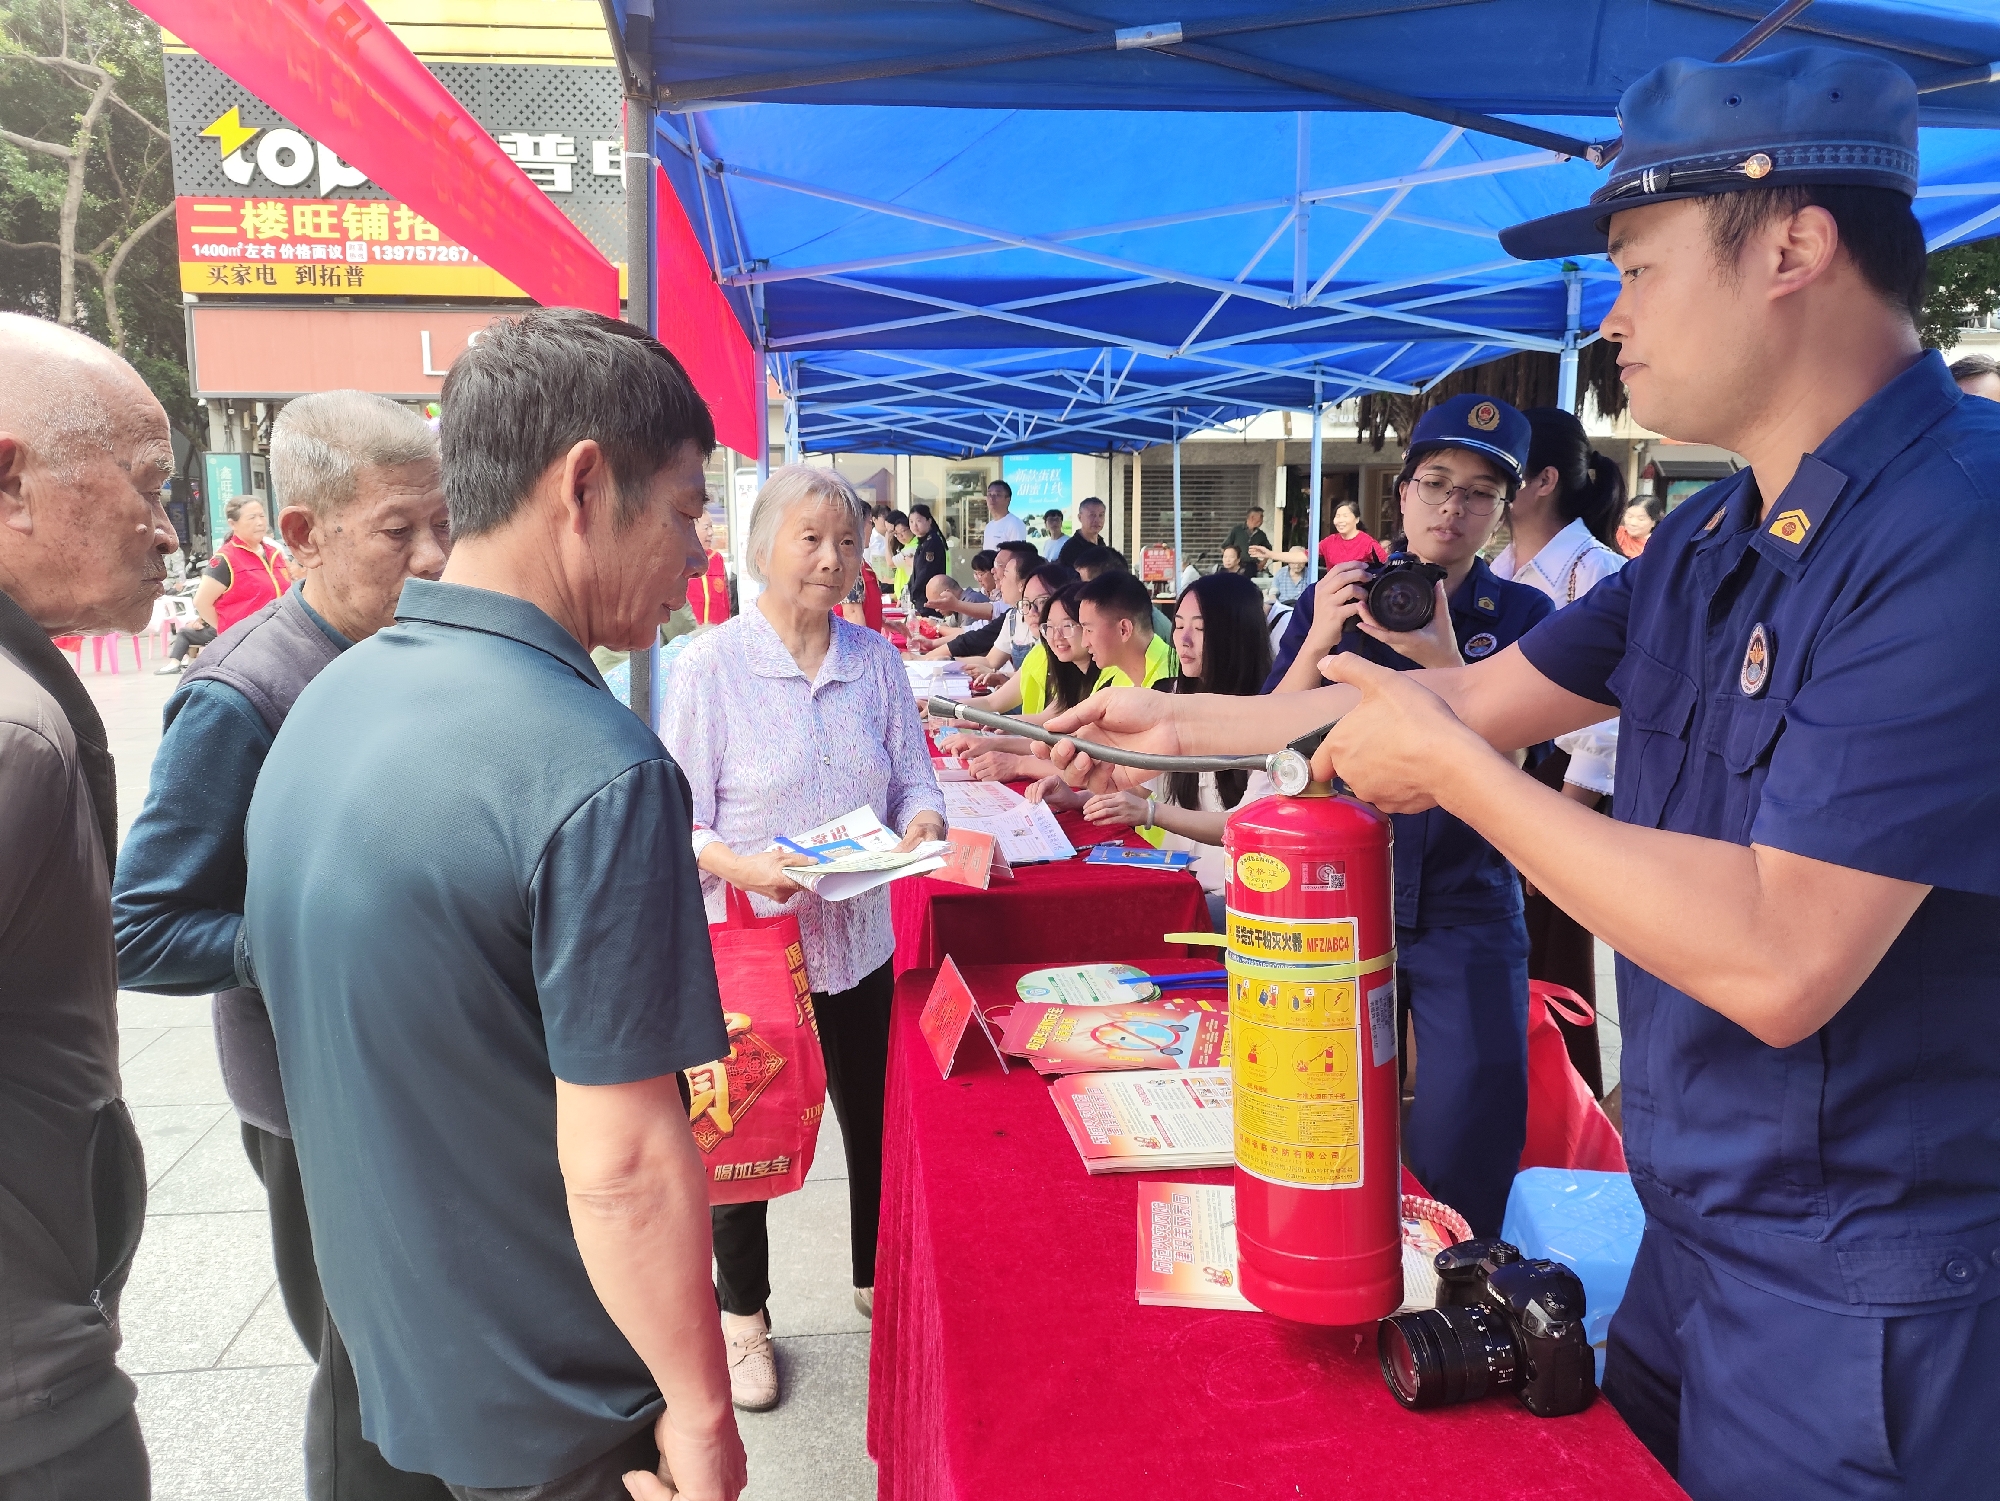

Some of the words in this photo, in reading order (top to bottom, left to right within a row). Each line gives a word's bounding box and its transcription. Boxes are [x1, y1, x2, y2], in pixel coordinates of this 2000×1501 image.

[190, 200, 440, 241] 二楼旺铺招
[279, 243, 343, 259] 价格面议
[371, 245, 478, 262] 139757267
[206, 263, 277, 286] 买家电
[295, 264, 365, 287] 到拓普
[1306, 936, 1350, 953] MFZ/ABC4
[714, 1155, 790, 1181] 喝加多宝
